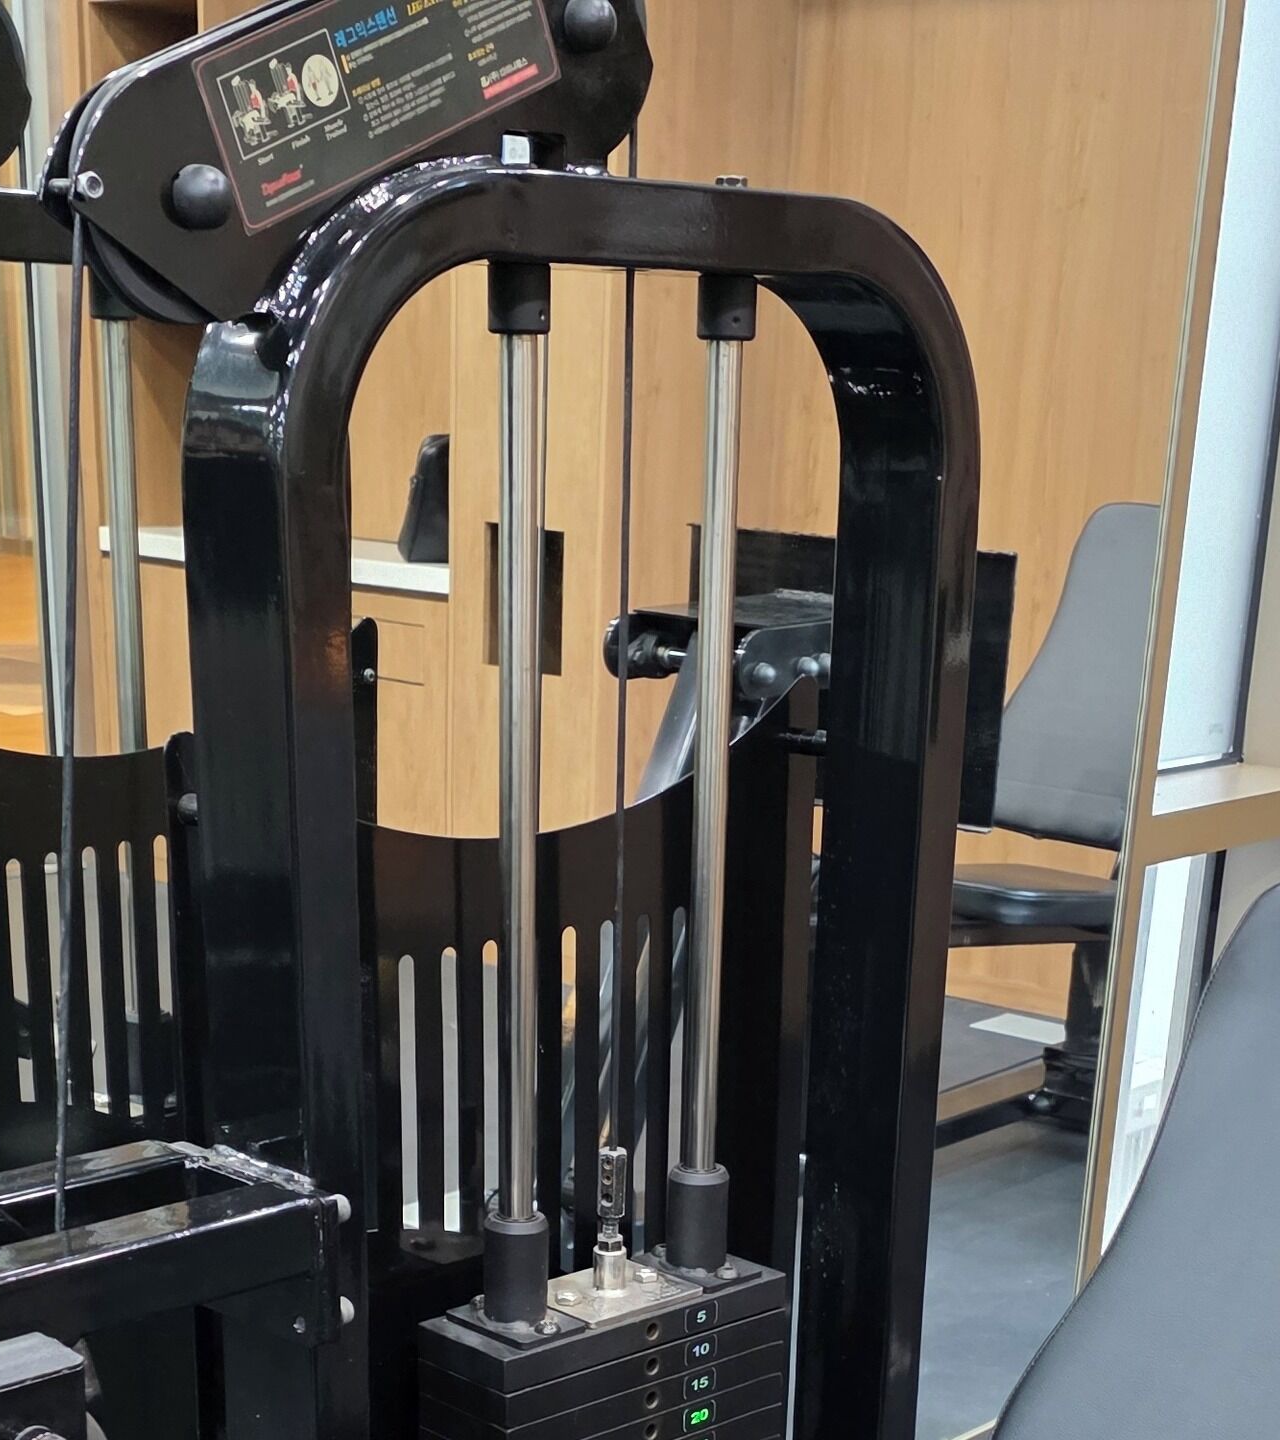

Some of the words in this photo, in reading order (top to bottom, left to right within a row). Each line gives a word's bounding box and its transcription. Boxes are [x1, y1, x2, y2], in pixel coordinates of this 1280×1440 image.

[696, 1309, 707, 1323] 5
[692, 1342, 710, 1357] 10
[691, 1375, 709, 1391] 15
[690, 1408, 709, 1425] 20
